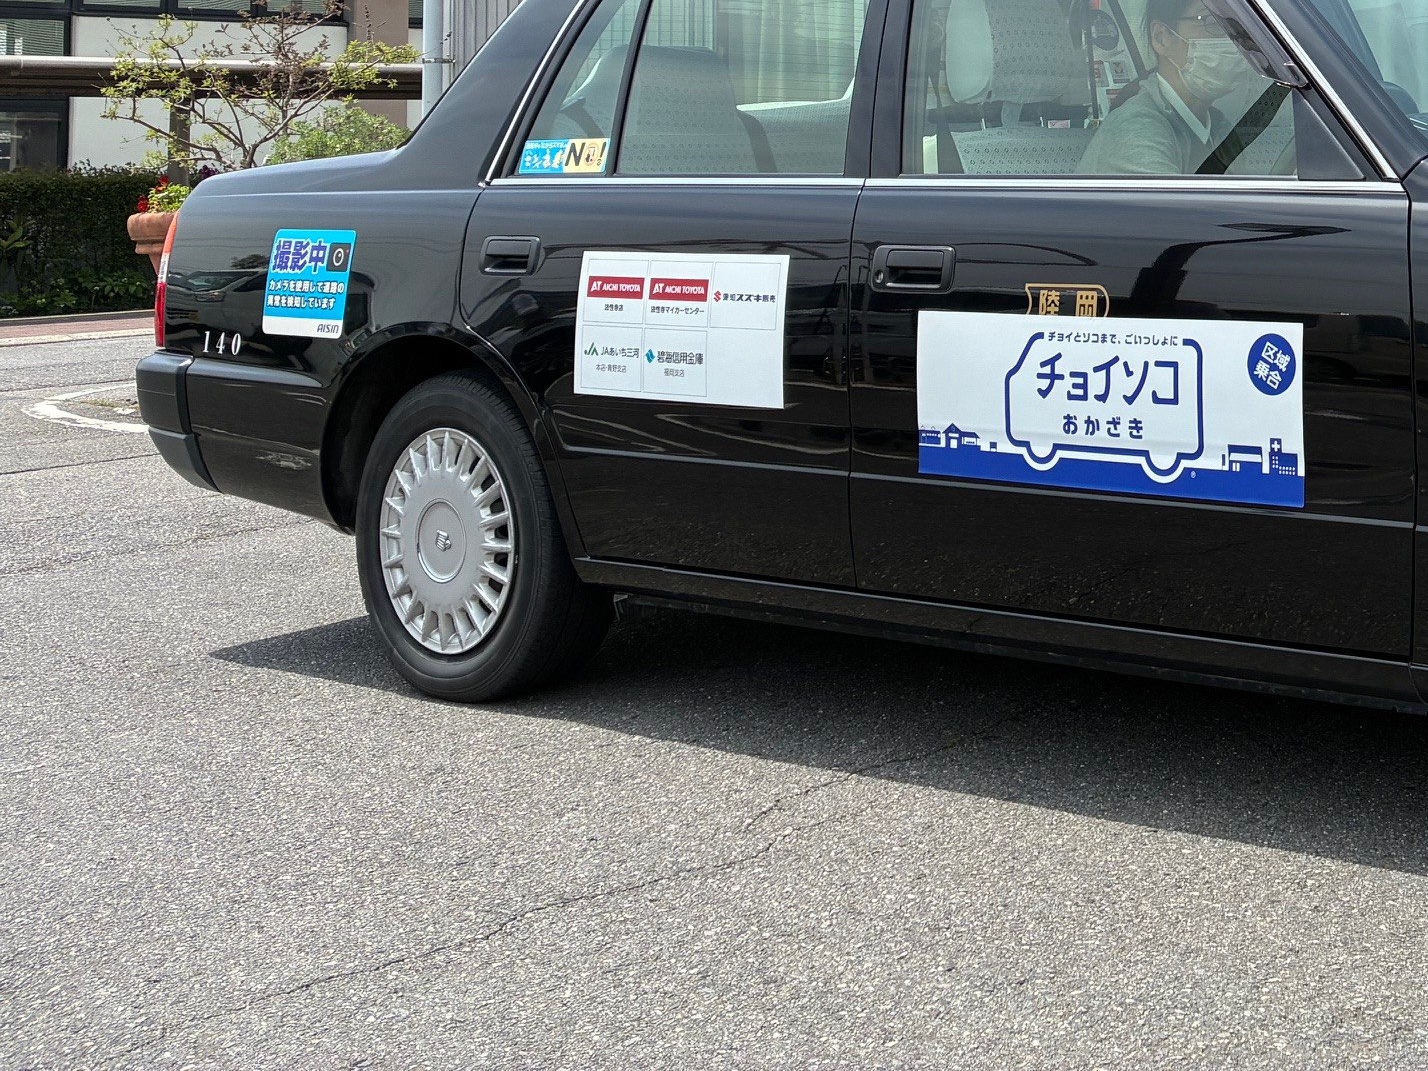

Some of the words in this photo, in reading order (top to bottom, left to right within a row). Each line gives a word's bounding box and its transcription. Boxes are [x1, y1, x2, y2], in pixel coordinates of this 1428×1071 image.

[272, 239, 328, 273] 撮影中
[602, 283, 618, 291] AICHI
[619, 283, 641, 292] TOYOTA
[665, 285, 681, 293] AICHI
[682, 286, 705, 294] TOYOTA
[316, 323, 339, 334] AISIN
[1047, 331, 1179, 347] チョイとソコまで、ごいっしょに
[203, 331, 241, 356] 140
[1261, 341, 1291, 372] 区域
[1036, 352, 1179, 406] チョイソコ
[1253, 359, 1282, 390] 乗合
[1062, 413, 1143, 439] おかざき
